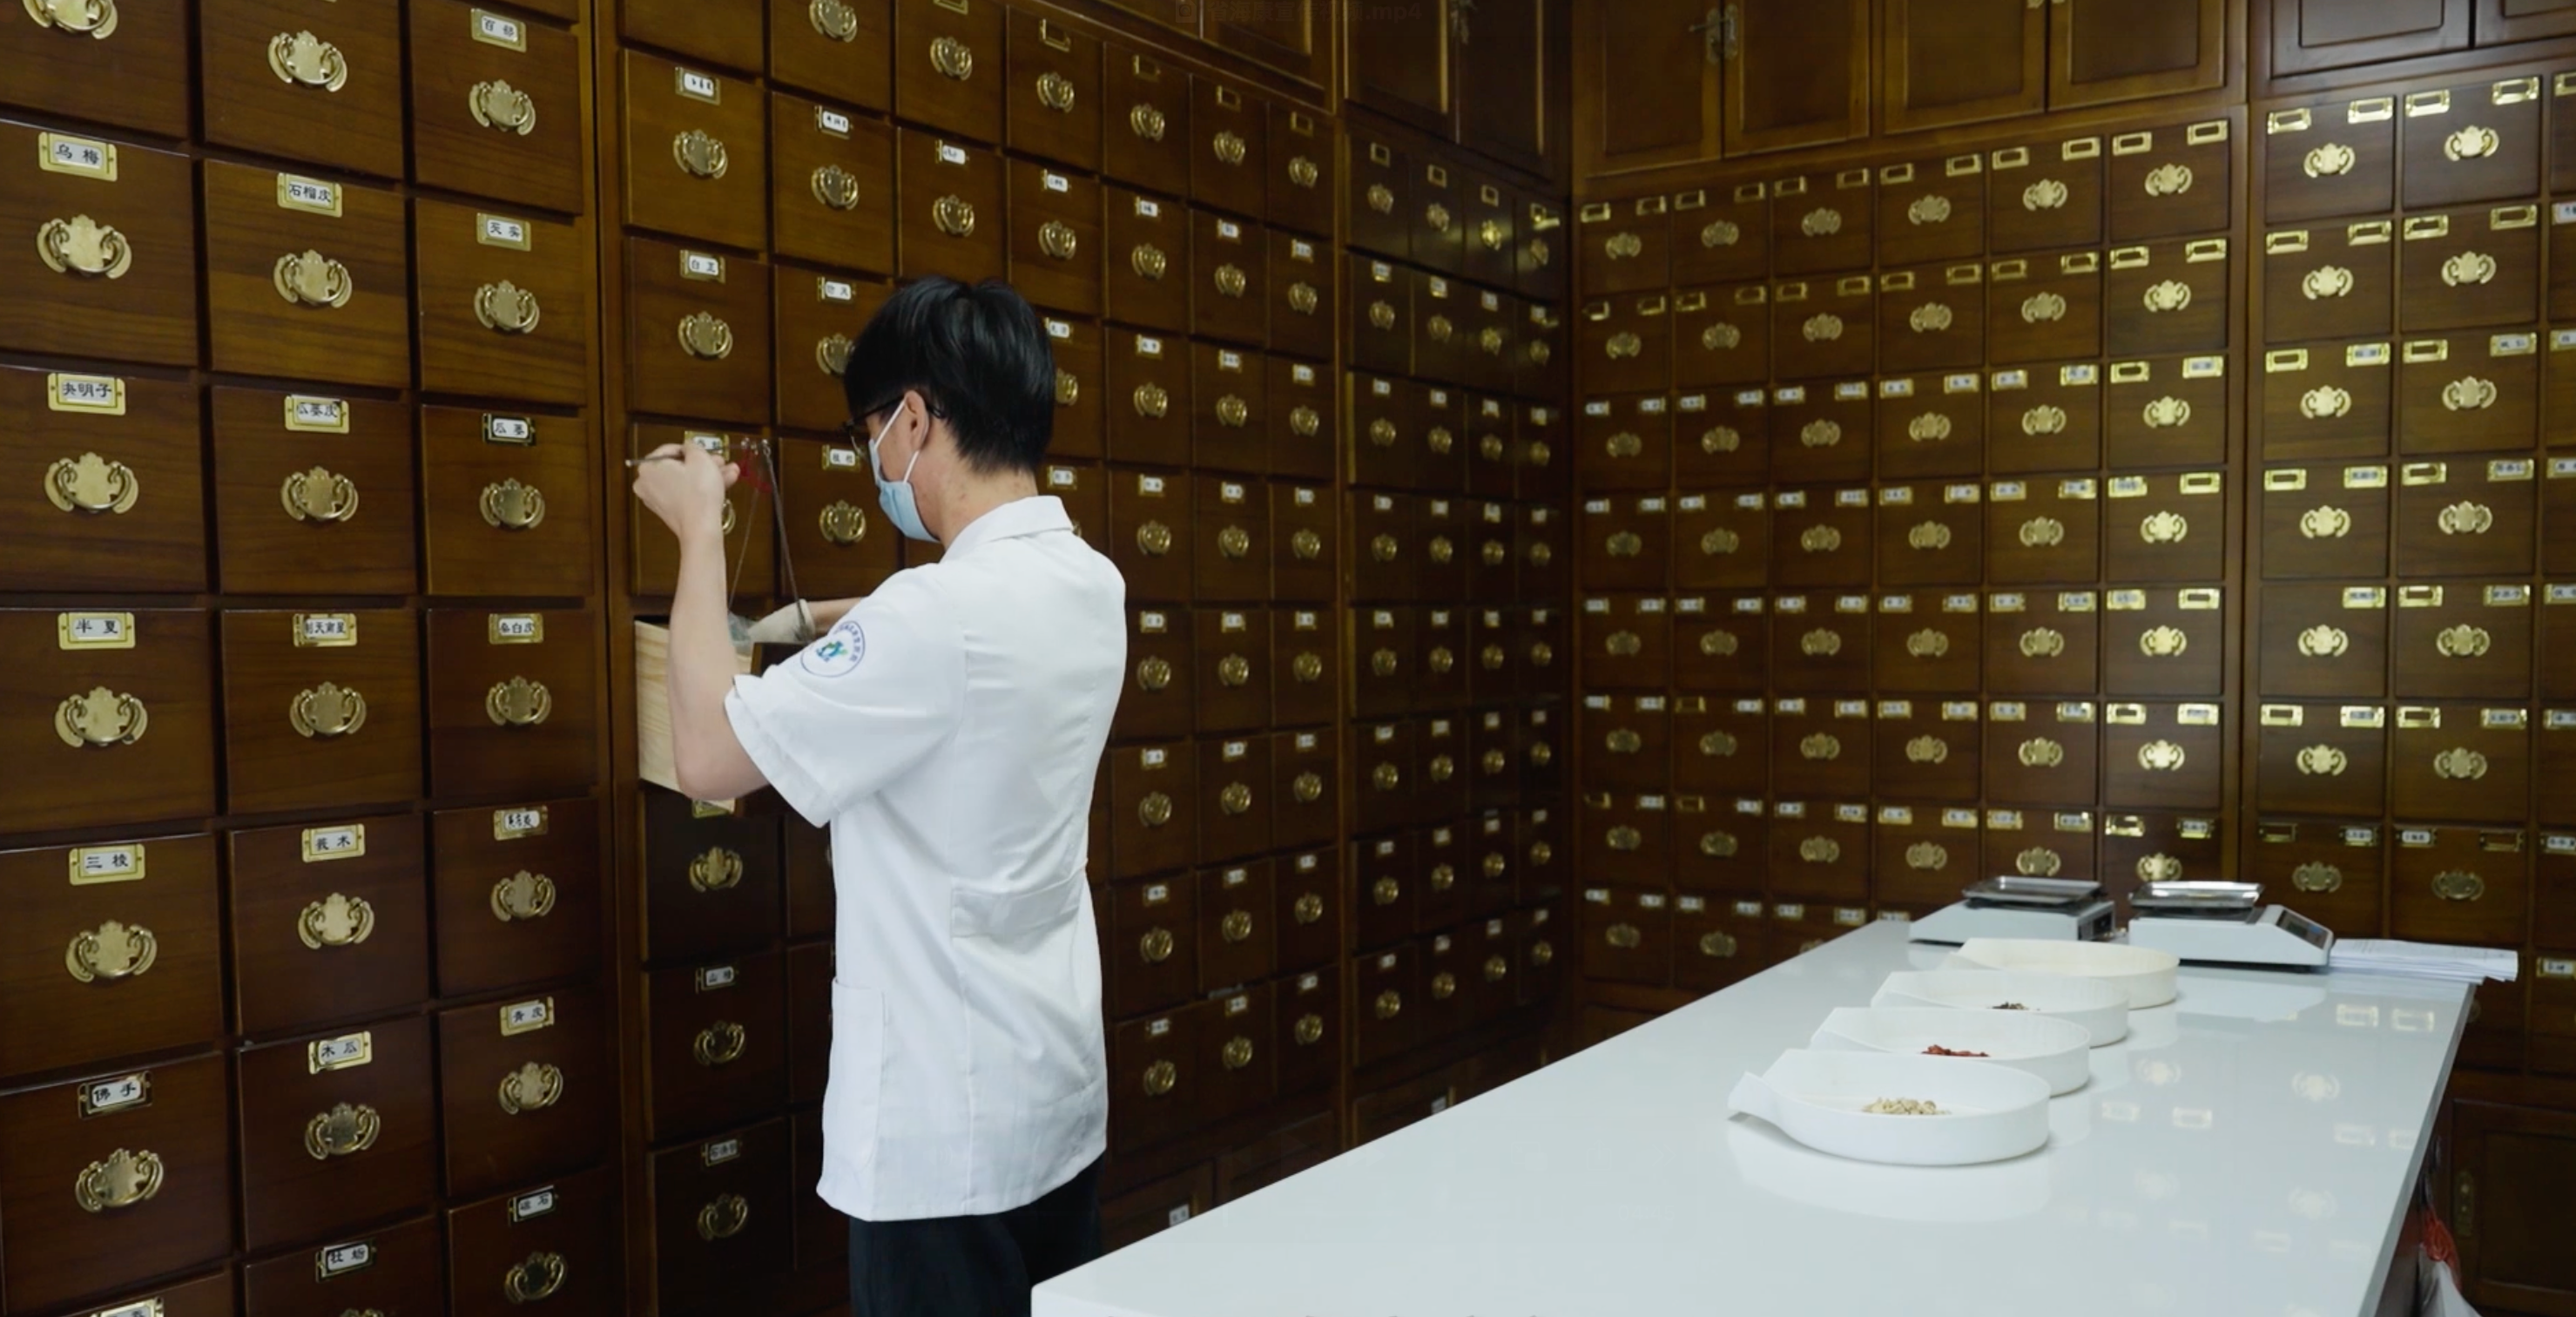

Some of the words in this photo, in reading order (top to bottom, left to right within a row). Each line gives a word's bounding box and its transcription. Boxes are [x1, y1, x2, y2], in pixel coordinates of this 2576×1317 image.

[56, 143, 100, 165] 乌梅
[287, 184, 333, 204] 石榴皮
[63, 380, 112, 398] 决明子
[76, 618, 119, 635] 半夏
[86, 850, 129, 869] 三棱
[512, 1005, 543, 1023] 青皮
[321, 1041, 358, 1059] 木瓜
[94, 1084, 137, 1103] 佛手
[331, 1248, 365, 1265] 牡蛎
